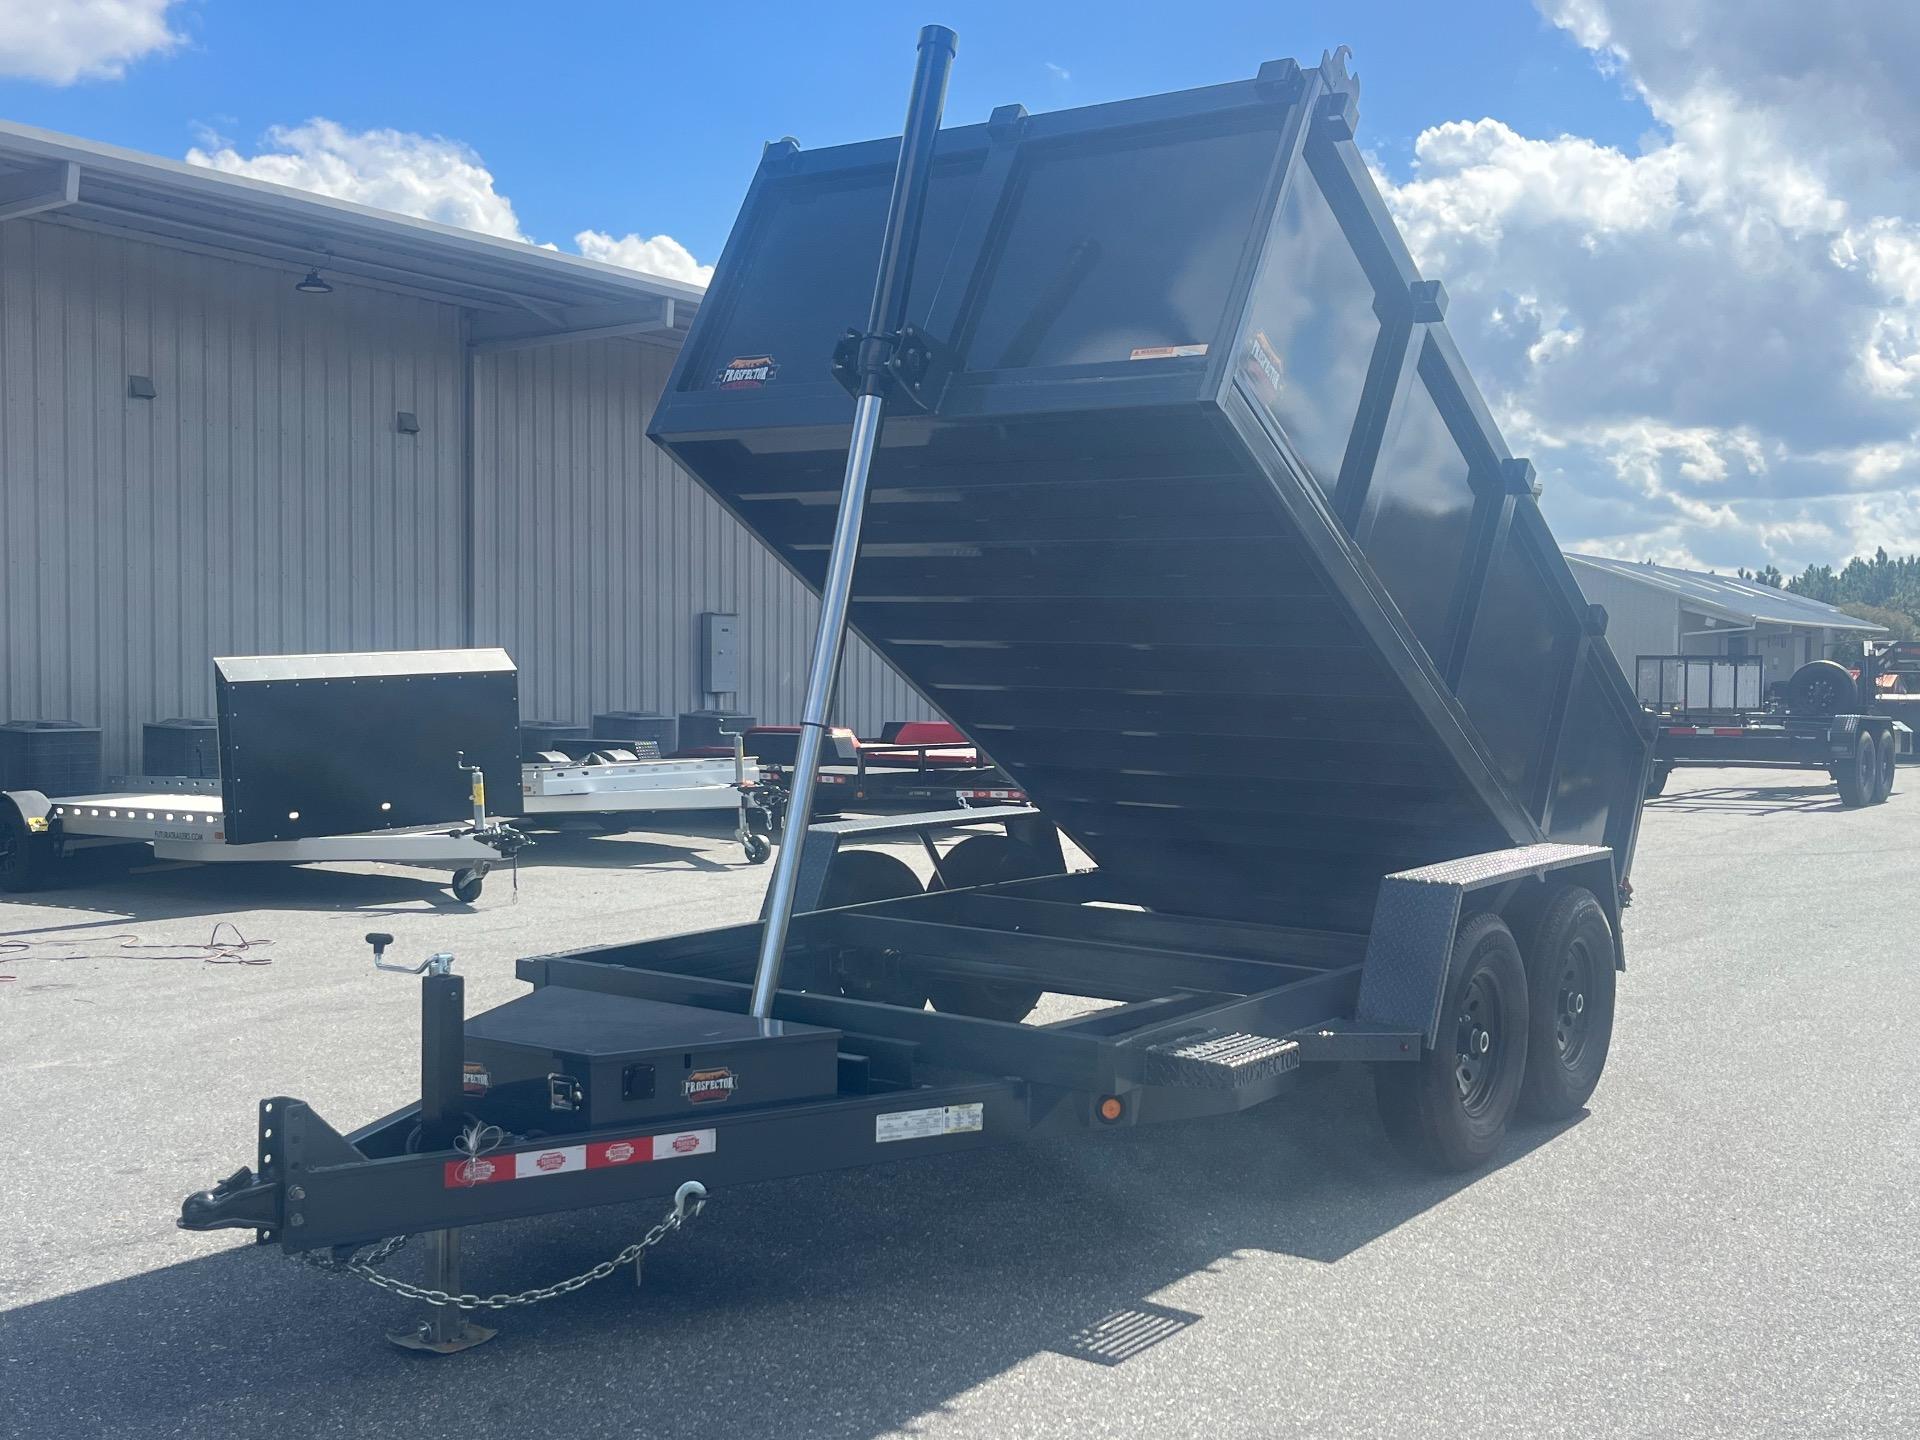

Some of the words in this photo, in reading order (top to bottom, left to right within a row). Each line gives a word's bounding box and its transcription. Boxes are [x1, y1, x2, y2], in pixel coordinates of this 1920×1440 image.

[722, 366, 768, 382] PROSPECTOR
[1251, 339, 1280, 391] PROSPECTOR
[1232, 1049, 1300, 1089] PROSPECTOR
[464, 1073, 489, 1086] SPECTOR
[685, 1076, 734, 1095] PROSPECTOR
